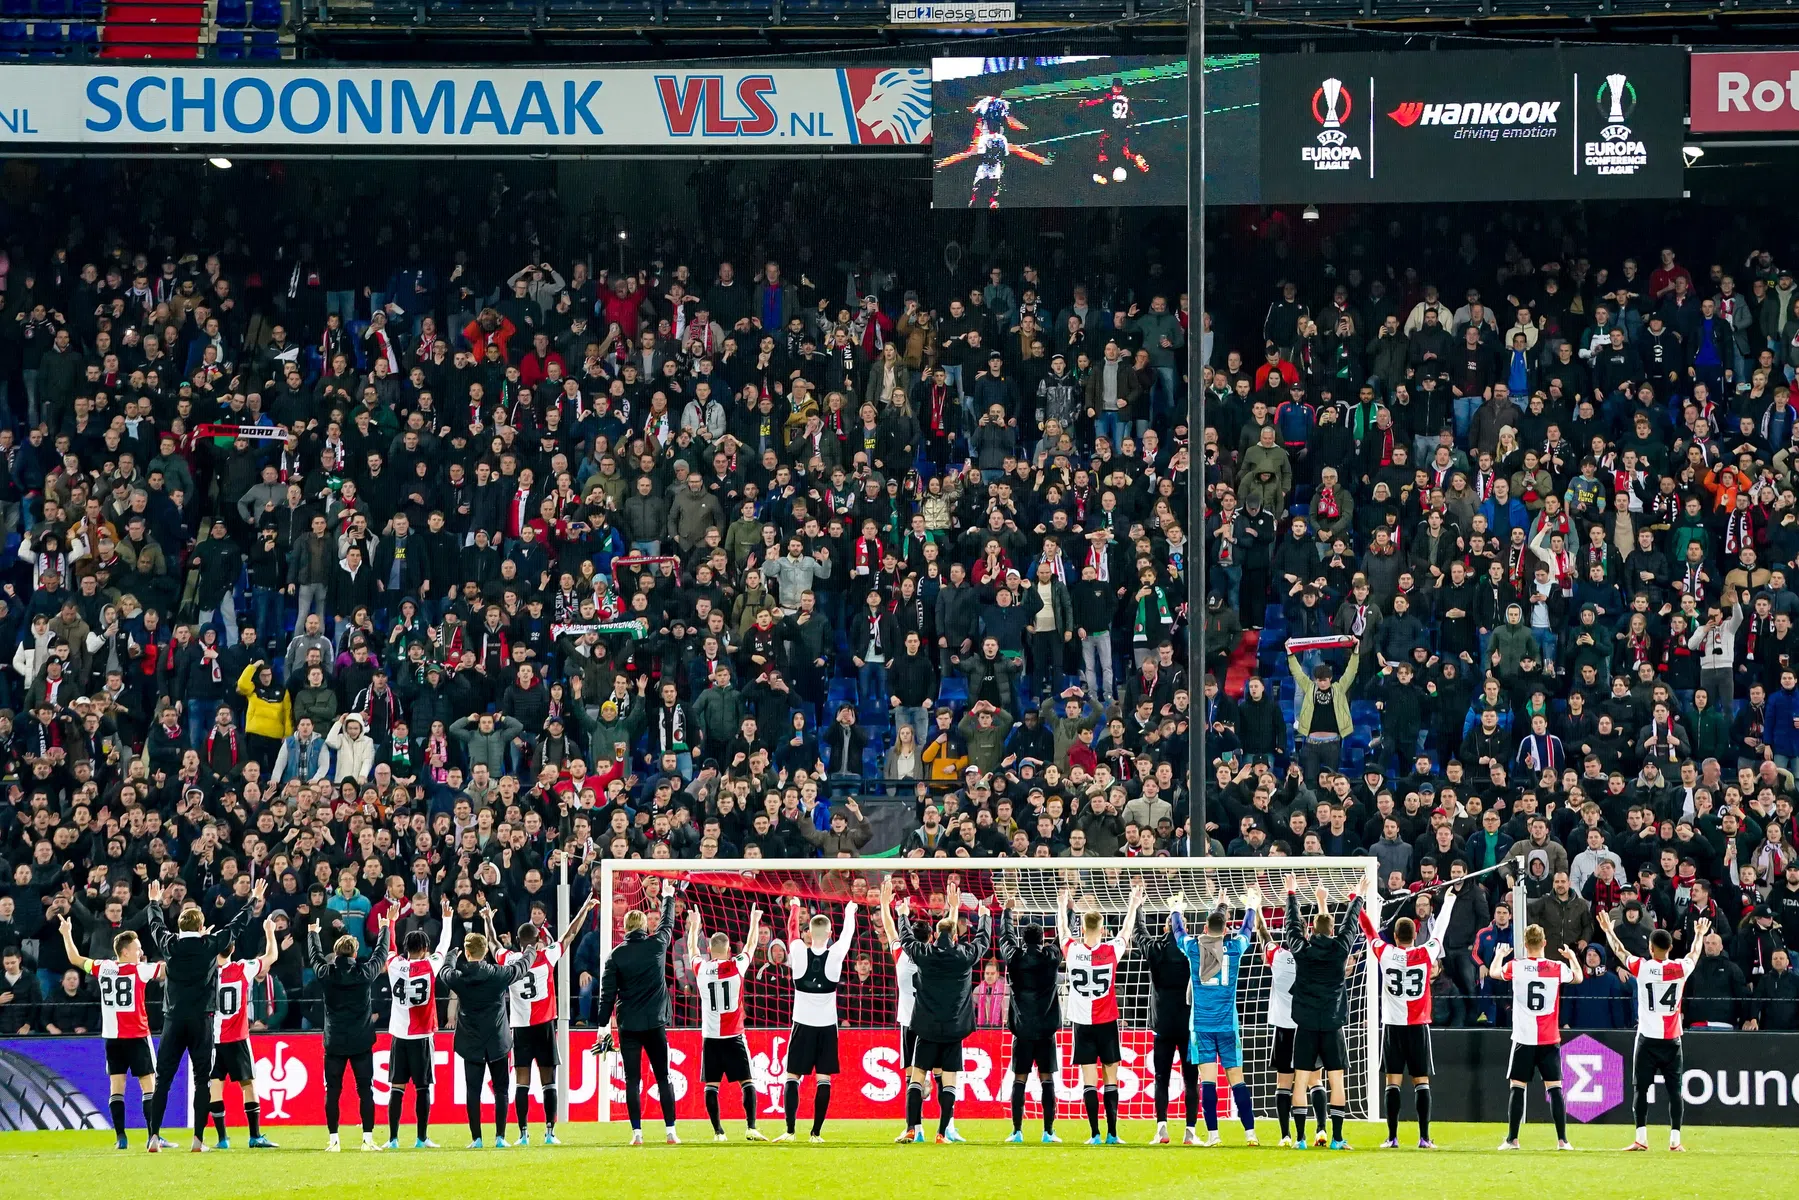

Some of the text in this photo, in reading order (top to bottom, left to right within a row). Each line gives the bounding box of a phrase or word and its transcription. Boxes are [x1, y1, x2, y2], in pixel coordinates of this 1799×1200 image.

[893, 7, 1012, 21] led2lease.com
[86, 76, 604, 136] SCHOONMAAK
[1112, 102, 1129, 119] 92
[1317, 130, 1347, 146] UEFA
[1453, 126, 1557, 141] driving emotion
[1600, 125, 1632, 141] UEFA
[1302, 147, 1361, 161] EUROPA
[1585, 141, 1647, 156] EUROPA
[1585, 155, 1647, 166] CONFERENCE
[1314, 160, 1350, 170] LEAGUE
[100, 976, 132, 1006] 28
[393, 977, 428, 1005] 43
[520, 971, 537, 1000] 3
[708, 981, 730, 1011] 11
[1071, 968, 1110, 997] 25
[1386, 967, 1424, 997] 33
[1527, 981, 1545, 1011] 6
[1645, 982, 1678, 1012] 14
[861, 1046, 1185, 1102] SRAUSS
